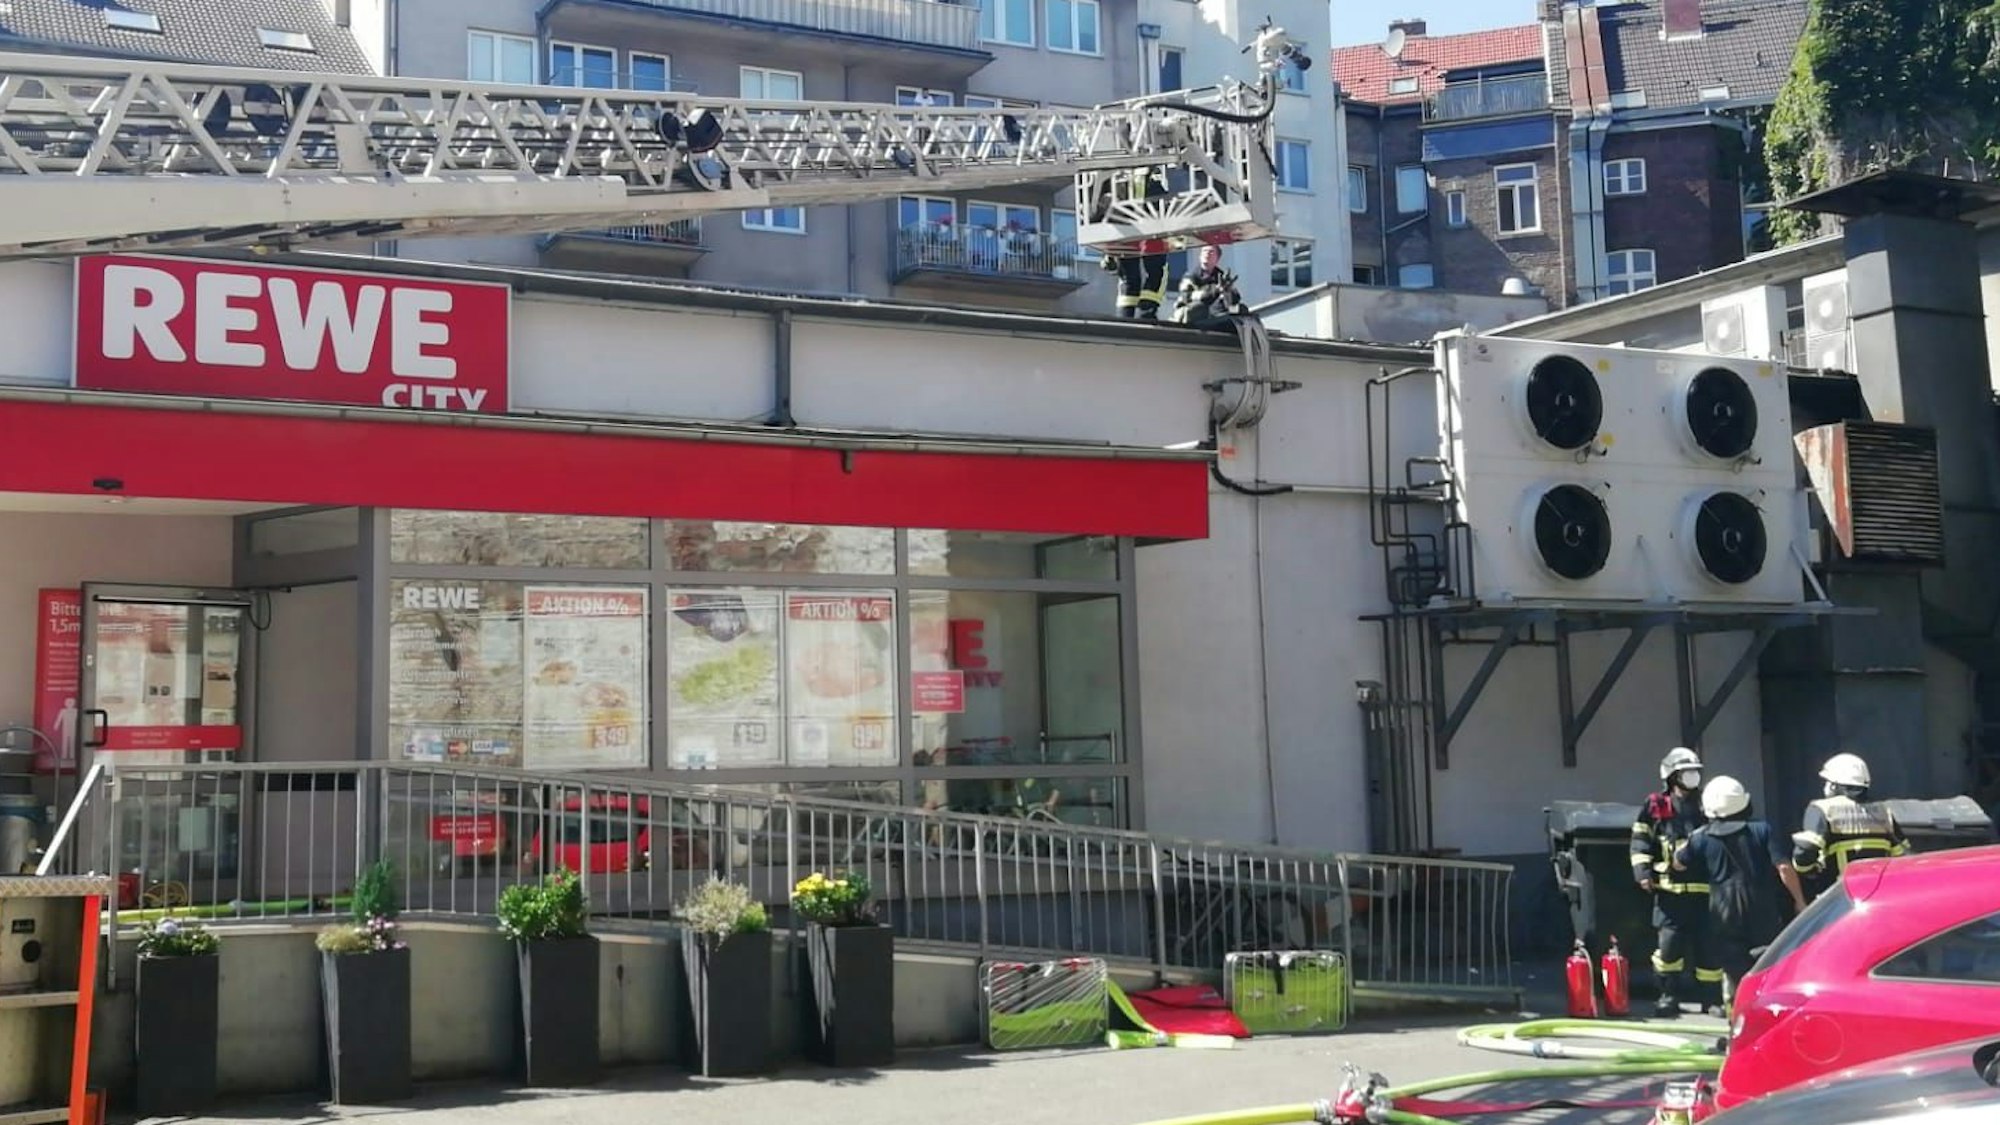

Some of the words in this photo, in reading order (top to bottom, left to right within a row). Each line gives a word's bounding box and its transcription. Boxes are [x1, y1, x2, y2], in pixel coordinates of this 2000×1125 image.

[102, 264, 458, 379] REWE
[382, 383, 488, 411] CITY
[403, 586, 479, 609] REWE
[543, 596, 603, 614] AKTION
[607, 597, 628, 615] %
[802, 602, 858, 618] AKTION
[861, 602, 880, 618] %
